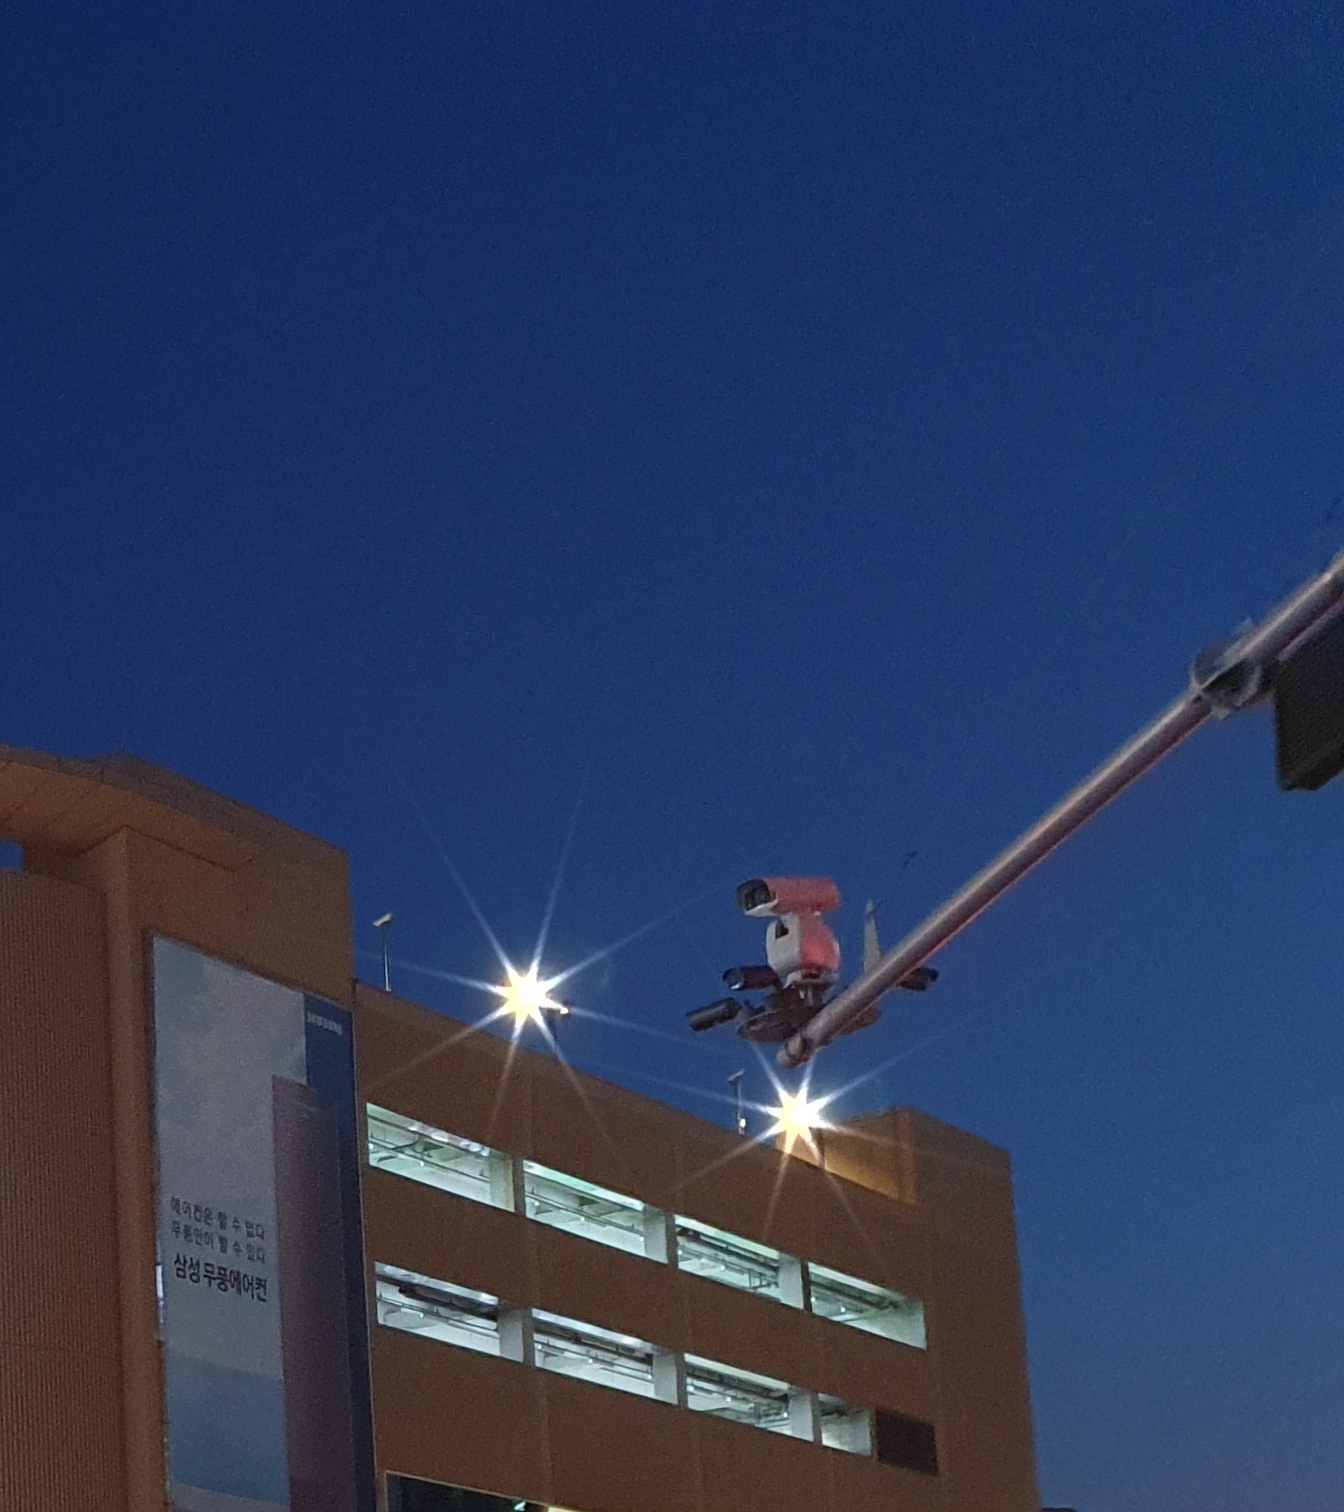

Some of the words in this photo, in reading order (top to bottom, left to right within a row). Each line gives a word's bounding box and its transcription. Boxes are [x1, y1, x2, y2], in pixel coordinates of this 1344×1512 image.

[171, 1196, 213, 1226] 에어컨은
[233, 1216, 241, 1233] 수
[233, 1241, 243, 1257] 수
[174, 1252, 201, 1284] 삼성
[203, 1262, 268, 1302] 무풍에어컨
